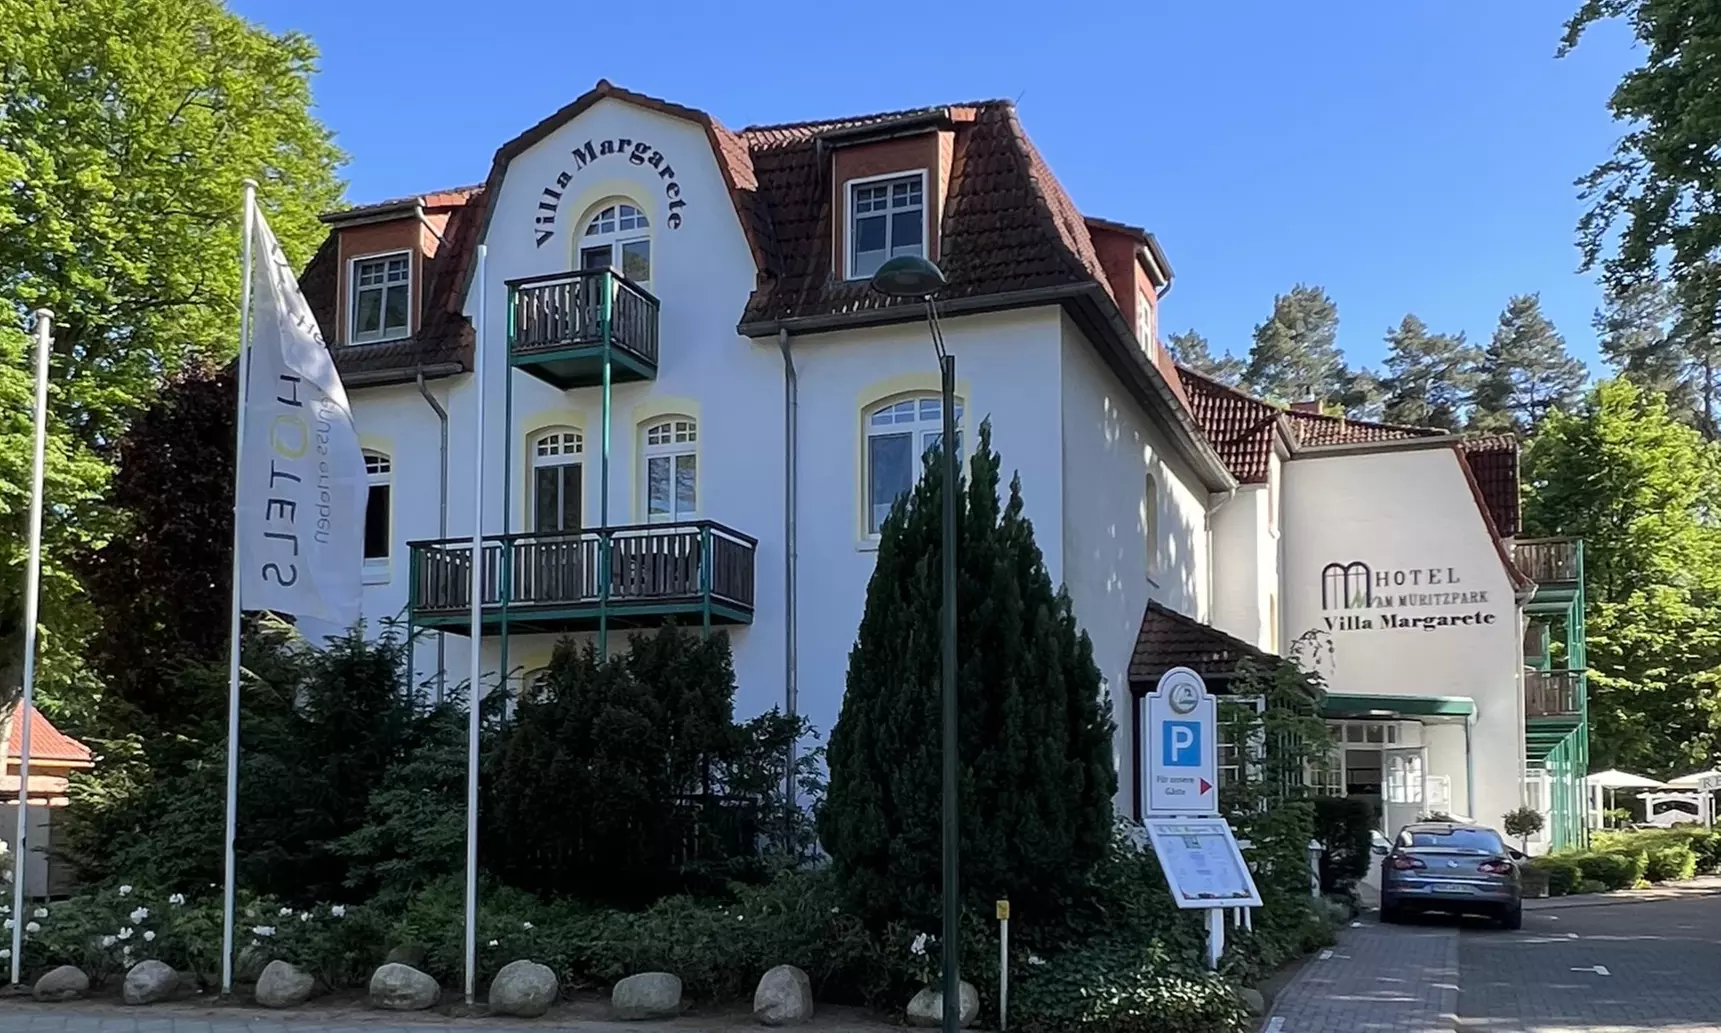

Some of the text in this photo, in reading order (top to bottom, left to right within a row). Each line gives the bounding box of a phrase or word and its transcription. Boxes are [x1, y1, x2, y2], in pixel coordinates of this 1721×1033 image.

[534, 138, 688, 249] Villa Margarete
[1375, 567, 1461, 588] HOTEL
[1375, 595, 1394, 608] AM
[1323, 611, 1497, 632] Villa Margarete
[1171, 726, 1194, 762] P
